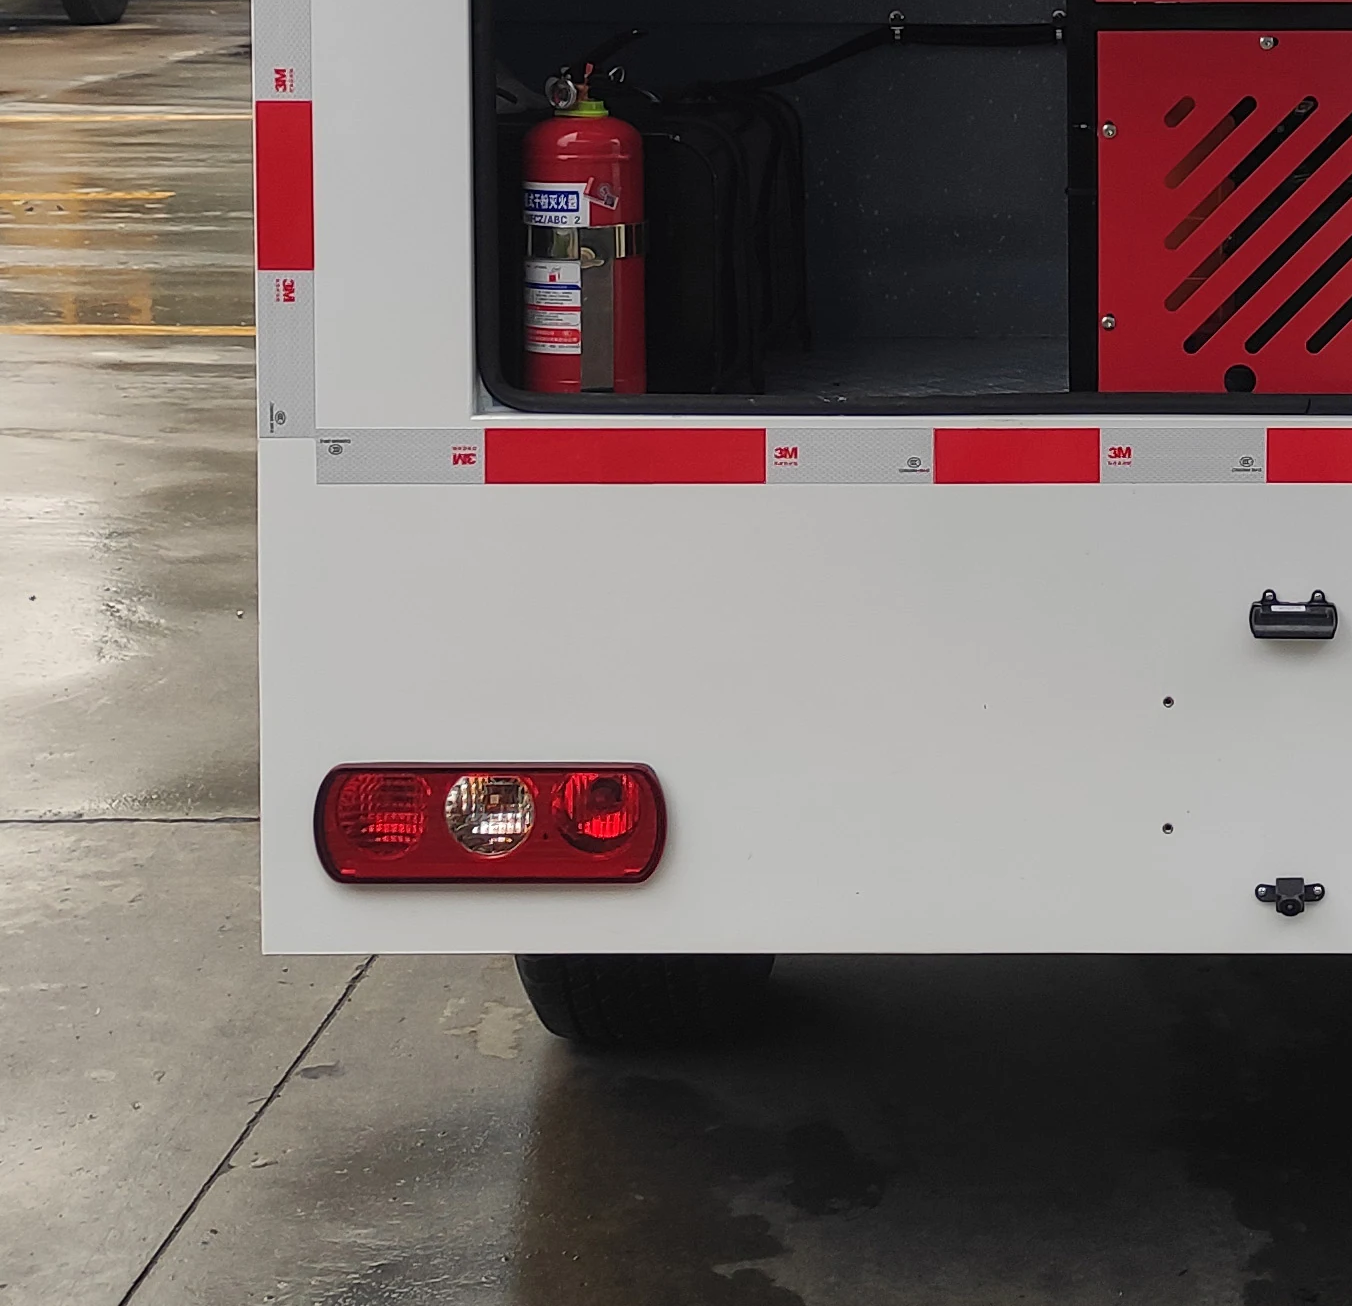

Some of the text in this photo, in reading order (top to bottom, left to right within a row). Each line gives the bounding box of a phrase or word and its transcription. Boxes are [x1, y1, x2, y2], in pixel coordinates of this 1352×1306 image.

[274, 68, 288, 93] 3M
[524, 192, 578, 210] 式干粉灭火器
[574, 216, 581, 225] 2
[282, 279, 295, 303] 3M
[452, 452, 477, 465] 3M
[774, 446, 799, 460] 3M
[1107, 446, 1133, 459] 3M
